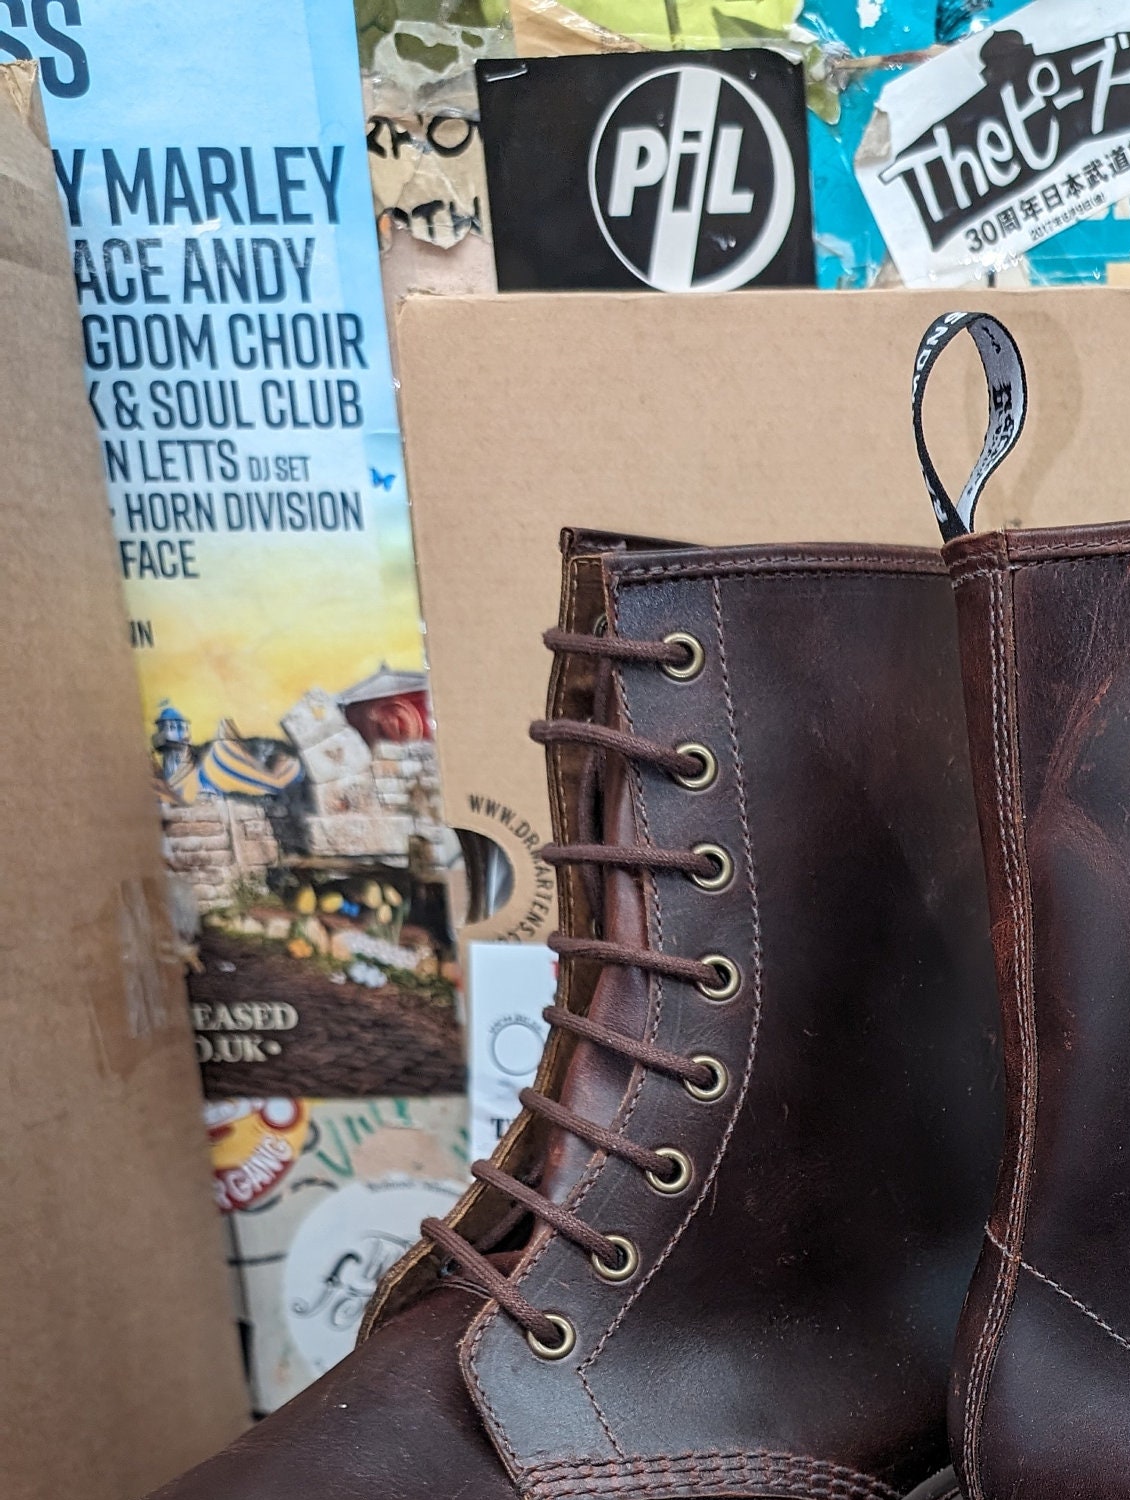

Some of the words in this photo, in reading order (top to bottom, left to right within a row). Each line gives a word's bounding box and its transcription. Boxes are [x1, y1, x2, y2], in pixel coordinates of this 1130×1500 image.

[102, 146, 345, 226] MARLEY
[74, 238, 171, 305] ACE
[183, 237, 316, 304] ANDY
[228, 312, 369, 370] CHOIR
[112, 380, 145, 431] &
[150, 379, 256, 430] SOUL
[261, 379, 364, 430] CLUB
[139, 439, 240, 484] LETTS
[249, 456, 272, 482] DJ
[275, 456, 311, 482] SET
[124, 493, 218, 533] HORN
[223, 491, 365, 533] DIVISION
[119, 539, 200, 580] FACE
[193, 1002, 298, 1031] EASED
